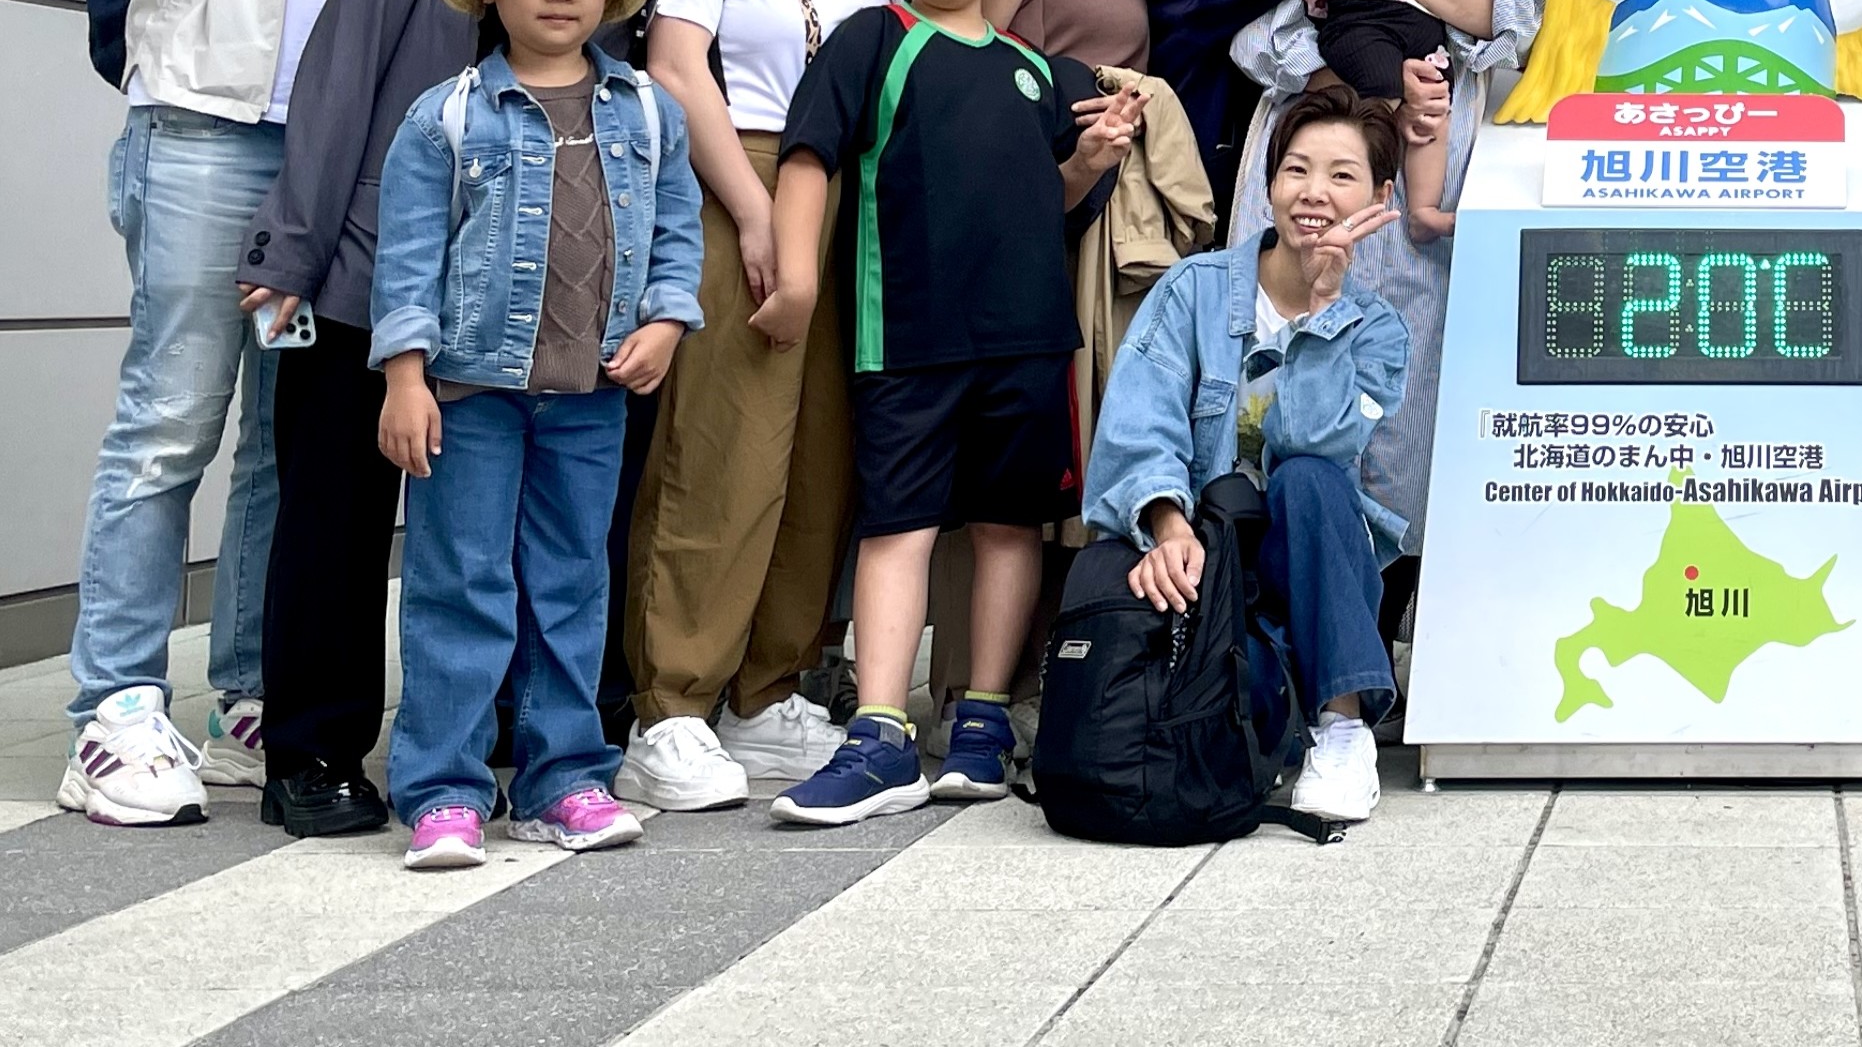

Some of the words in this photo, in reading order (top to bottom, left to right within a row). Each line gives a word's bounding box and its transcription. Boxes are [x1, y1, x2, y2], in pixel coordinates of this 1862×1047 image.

[1614, 102, 1778, 125] あさっぴー
[1659, 126, 1731, 137] ASAPPY
[1581, 149, 1807, 183] 旭川空港
[1582, 188, 1711, 199] ASAHIKAWA
[1718, 188, 1805, 199] AIRPORT
[1514, 444, 1824, 469] 北海道のまん中・旭川空港
[1485, 481, 1553, 503] Center
[1557, 481, 1577, 503] of
[1685, 587, 1749, 617] 旭川
